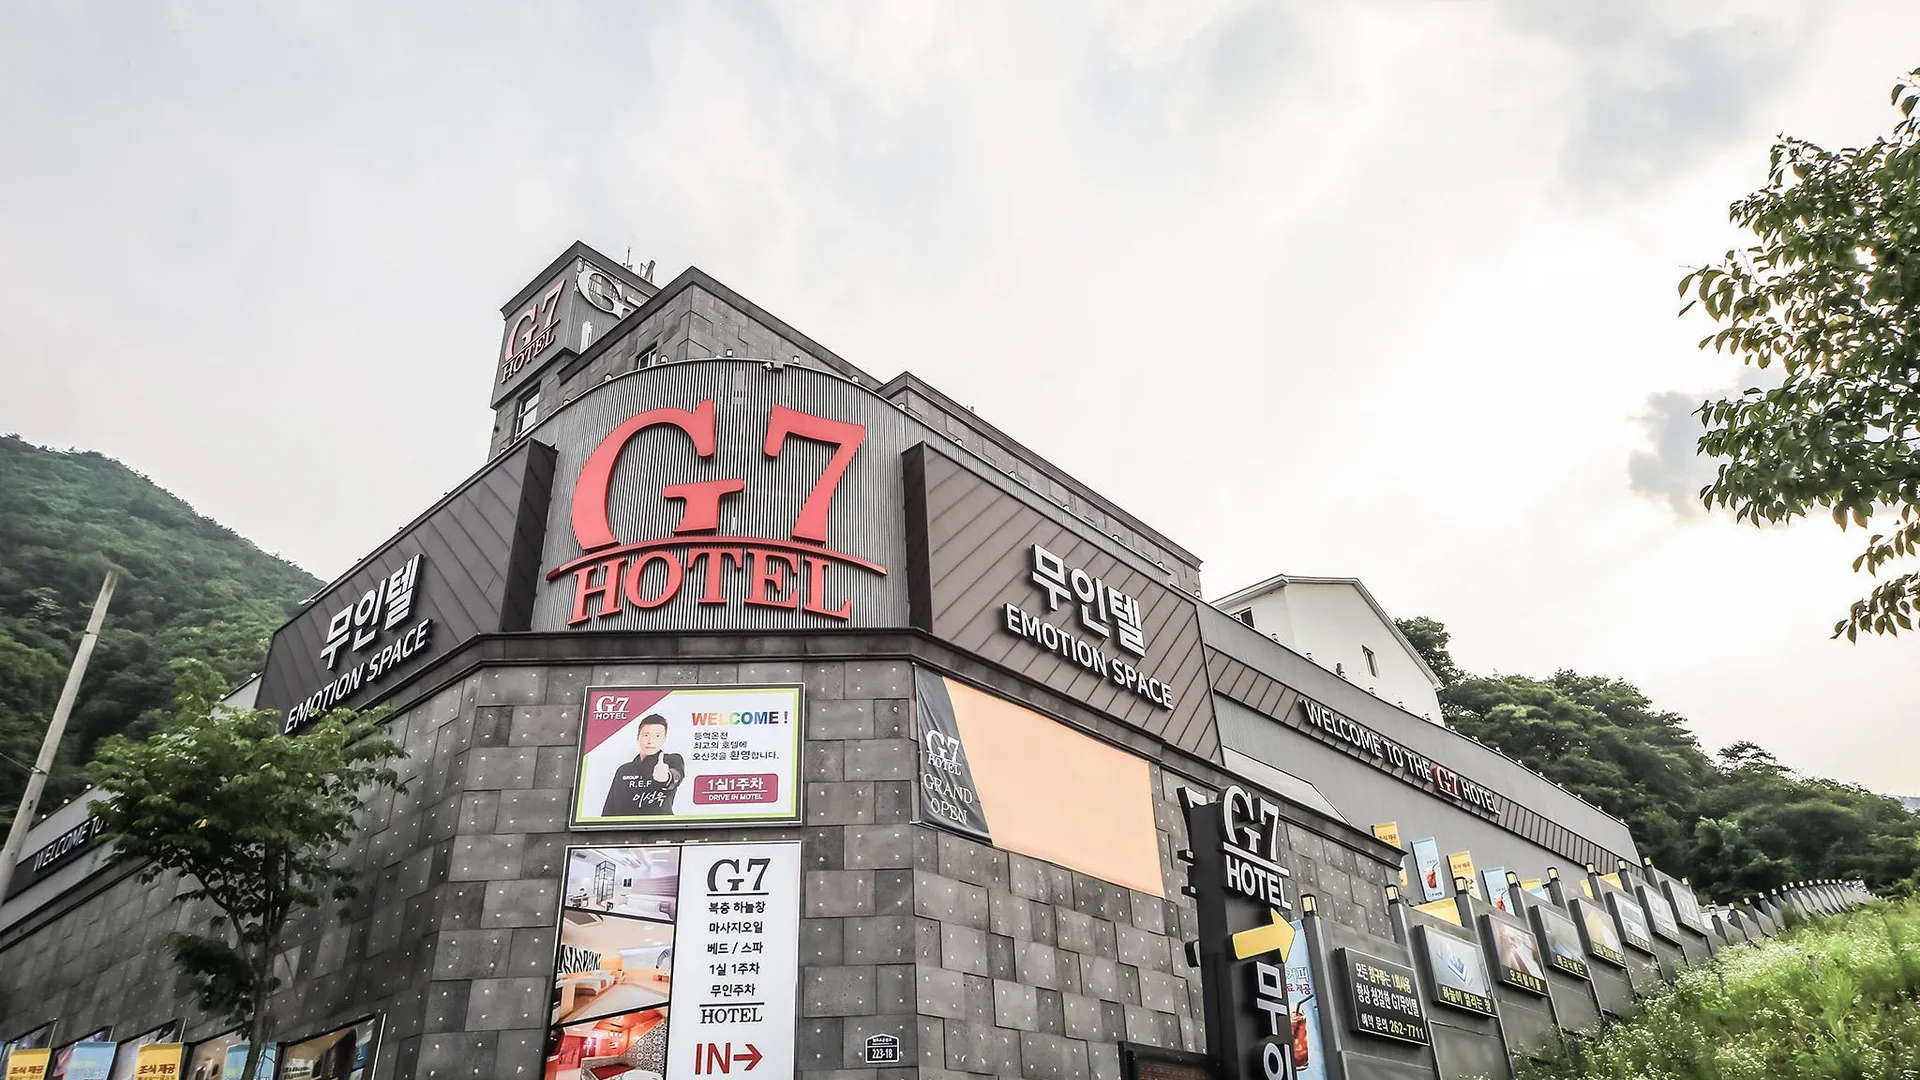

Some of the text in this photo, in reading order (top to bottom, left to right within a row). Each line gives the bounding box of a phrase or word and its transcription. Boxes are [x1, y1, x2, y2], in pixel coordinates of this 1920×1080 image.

[576, 264, 642, 320] G
[504, 278, 566, 361] G7
[501, 328, 556, 384] HOTEL
[571, 399, 867, 551] G7
[566, 547, 852, 627] HOTEL
[320, 554, 424, 670] 무인텔
[1031, 543, 1146, 658] 무인텔
[1003, 602, 1174, 711] EMOTION SPACE
[284, 618, 432, 735] EMOTION SPACE
[595, 695, 630, 713] G7
[595, 712, 627, 720] HOTEL
[691, 711, 779, 726] WELCOME
[692, 750, 779, 761] 오신것을 환영합니다.
[693, 740, 748, 750] 최고의 호텔에
[926, 729, 961, 763] G7
[926, 753, 962, 776] HOTEL
[1300, 700, 1501, 816] WELCOME TO THE G7 HOTEL
[629, 780, 652, 788] R.E.F
[708, 777, 764, 791] 1실1주차
[923, 773, 973, 804] GRAND
[930, 798, 968, 825] OPEN
[1223, 785, 1280, 862] G7
[32, 822, 91, 874] WELCOME
[706, 858, 771, 892] G7
[1225, 854, 1293, 911] HOTEL
[708, 900, 766, 914] 복층 하늘창
[709, 921, 763, 934] 마사지오일
[707, 942, 729, 955] 베드
[740, 941, 763, 954] 스파
[709, 962, 760, 976] 1실 1주차
[1355, 962, 1369, 981] 모든
[710, 983, 756, 997] 무인주차
[1355, 982, 1371, 1005] 항상
[700, 1007, 763, 1024] HOTEL
[1375, 1016, 1389, 1033] 문의
[1388, 1018, 1425, 1040] 262-7711
[695, 1042, 731, 1075] IN
[872, 1048, 893, 1059] 223-18
